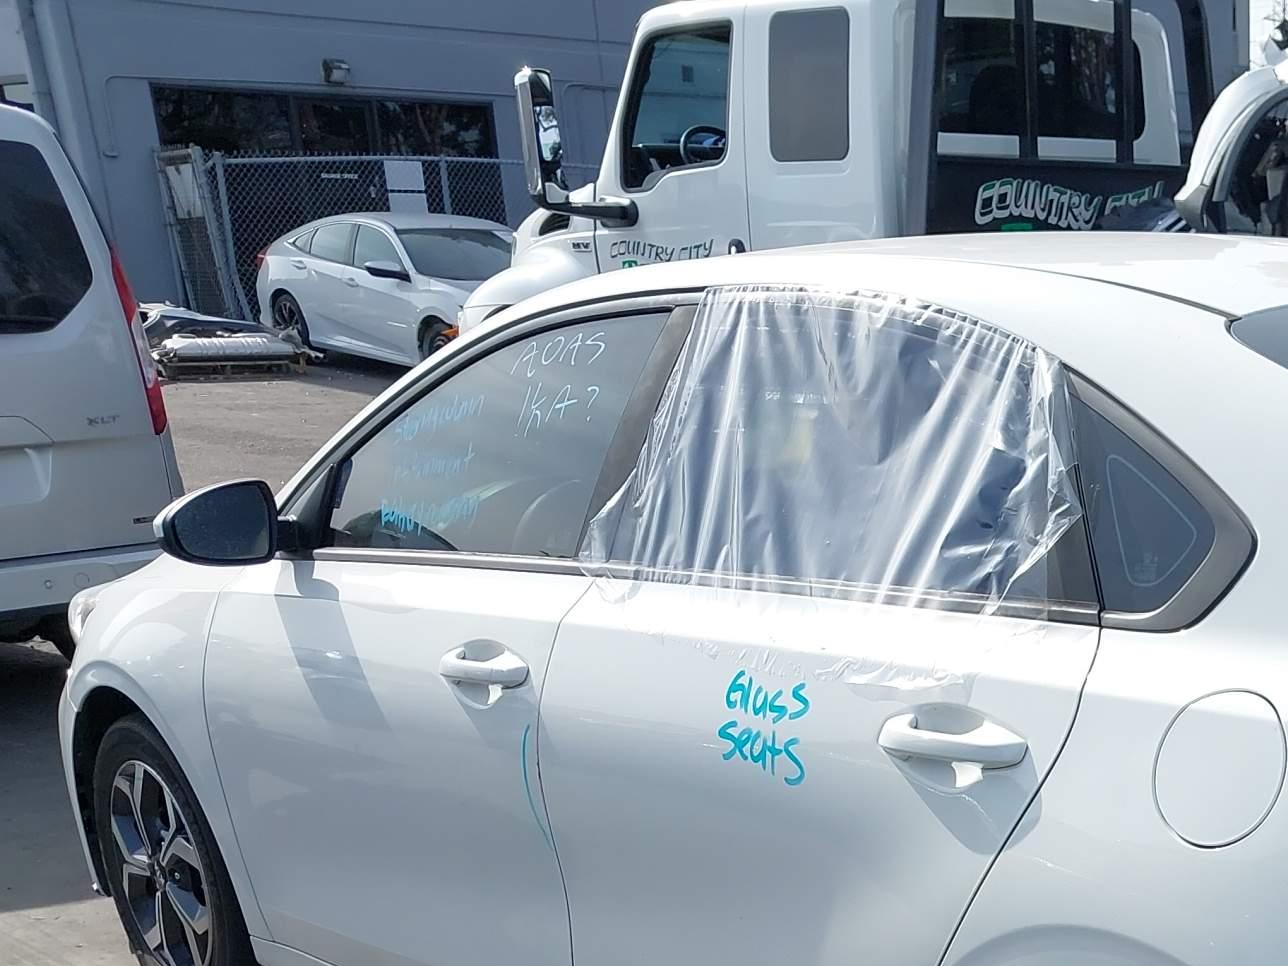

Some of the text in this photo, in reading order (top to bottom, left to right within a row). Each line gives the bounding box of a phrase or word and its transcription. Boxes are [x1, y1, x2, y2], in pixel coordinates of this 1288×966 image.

[974, 178, 1102, 230] COUNTRY
[610, 239, 675, 262] COUNTRY
[86, 414, 120, 427] XLT
